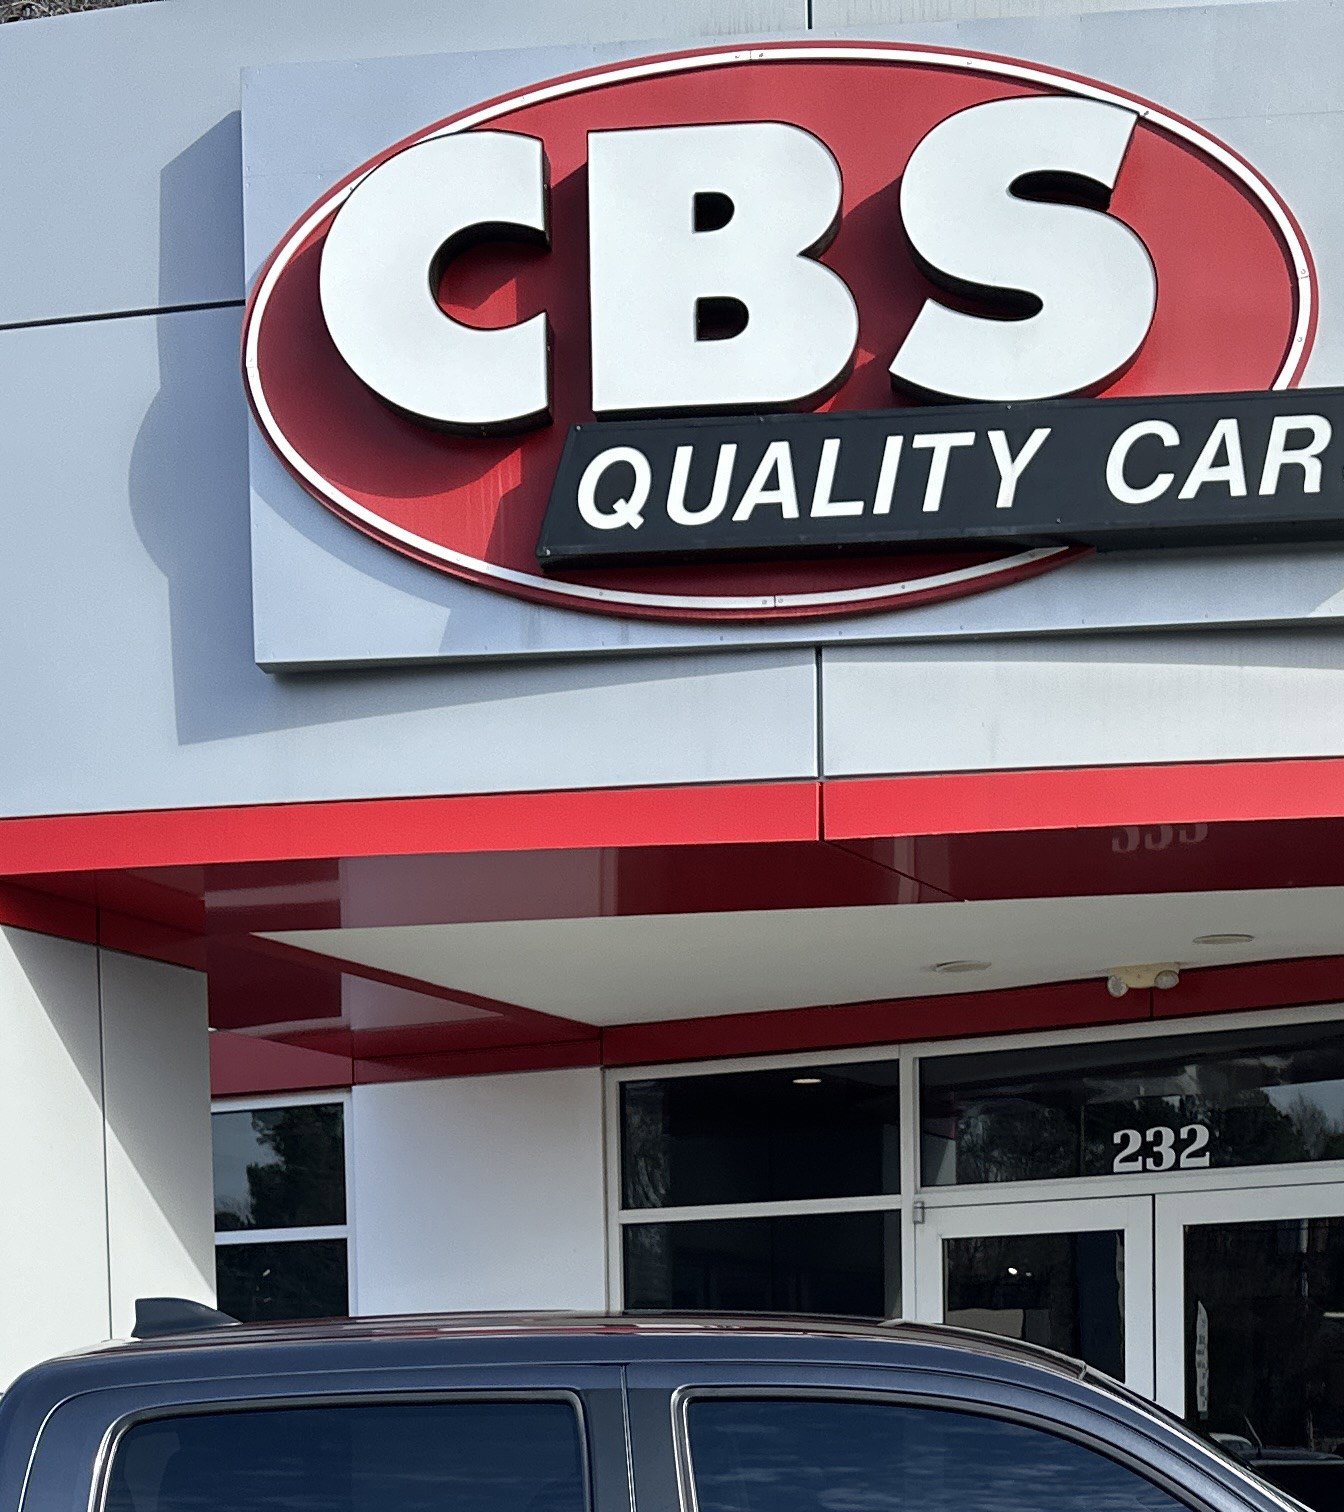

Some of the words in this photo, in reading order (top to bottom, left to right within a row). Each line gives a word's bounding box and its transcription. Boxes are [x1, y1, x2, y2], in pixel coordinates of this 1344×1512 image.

[320, 94, 1159, 430] CBS
[576, 427, 1052, 531] QUALITY
[1112, 1124, 1210, 1173] 232
